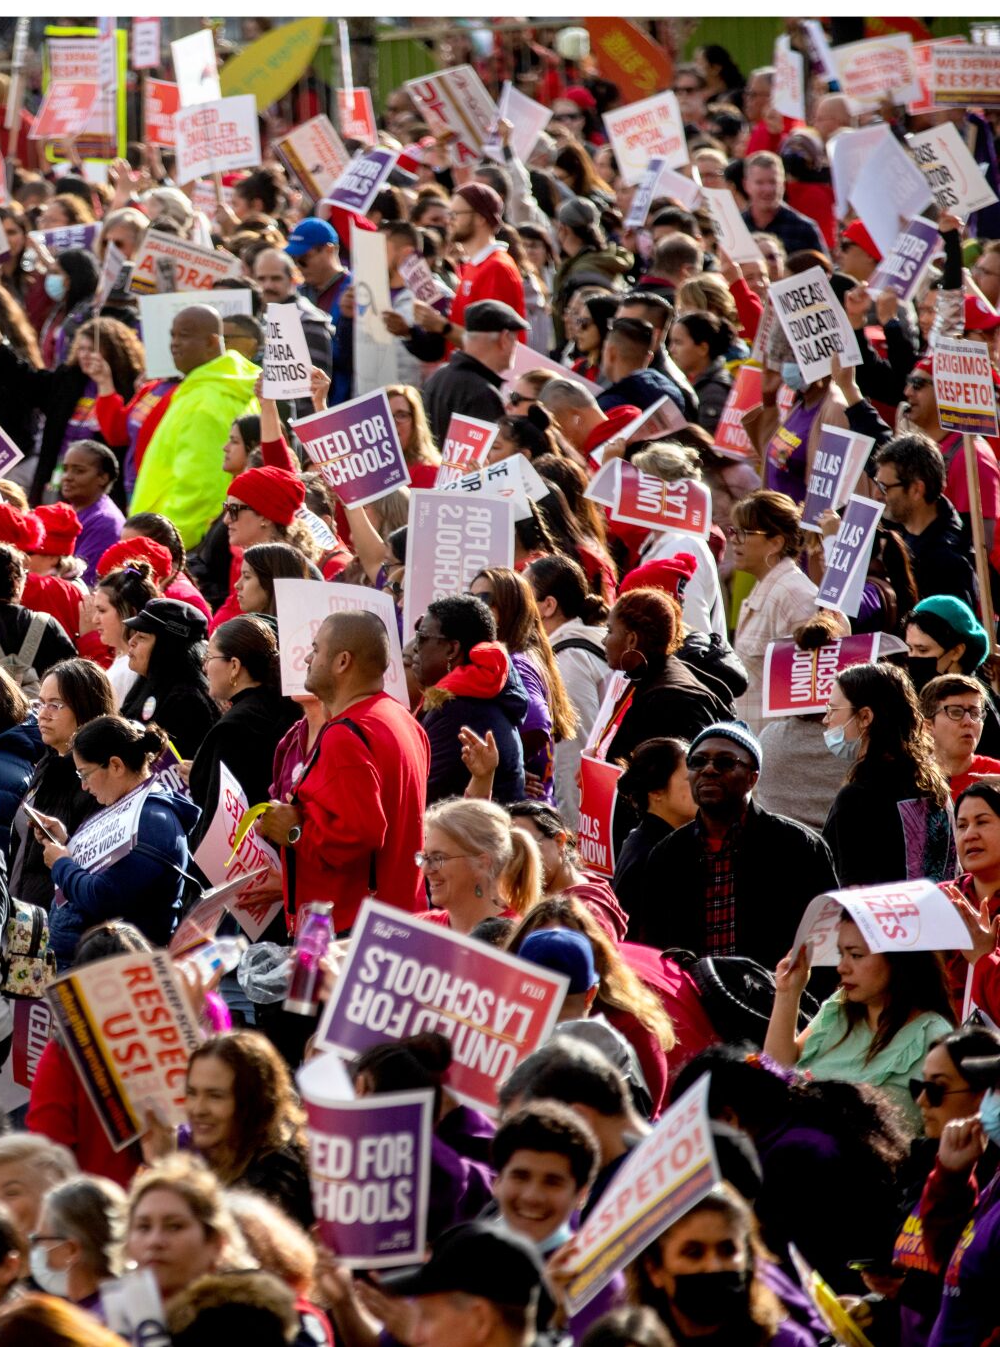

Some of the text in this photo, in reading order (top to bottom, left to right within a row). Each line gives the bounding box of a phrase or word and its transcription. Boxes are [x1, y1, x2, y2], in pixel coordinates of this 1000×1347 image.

[139, 254, 214, 290] AORA
[778, 282, 827, 315] INCREASE
[271, 322, 283, 339] DE
[789, 309, 840, 342] EDUCATOR
[798, 333, 844, 366] SALARIES
[935, 352, 990, 377] ¡EXIGIMOS
[264, 363, 307, 381] AESTROS
[937, 379, 993, 406] RESPETO!
[350, 414, 389, 449] FOR
[320, 440, 396, 487] SCHOOLS
[72, 842, 83, 856] DE
[99, 827, 126, 854] VIDAS!
[581, 838, 607, 867] NOW
[152, 956, 163, 977] WE
[358, 944, 534, 1044] LA SCHOOLS
[520, 979, 547, 1001] UTLA
[56, 983, 91, 1047] education
[346, 983, 408, 1039] FOR
[103, 1012, 153, 1080] US!
[122, 965, 189, 1106] RESPEC
[357, 1133, 414, 1179] FOR
